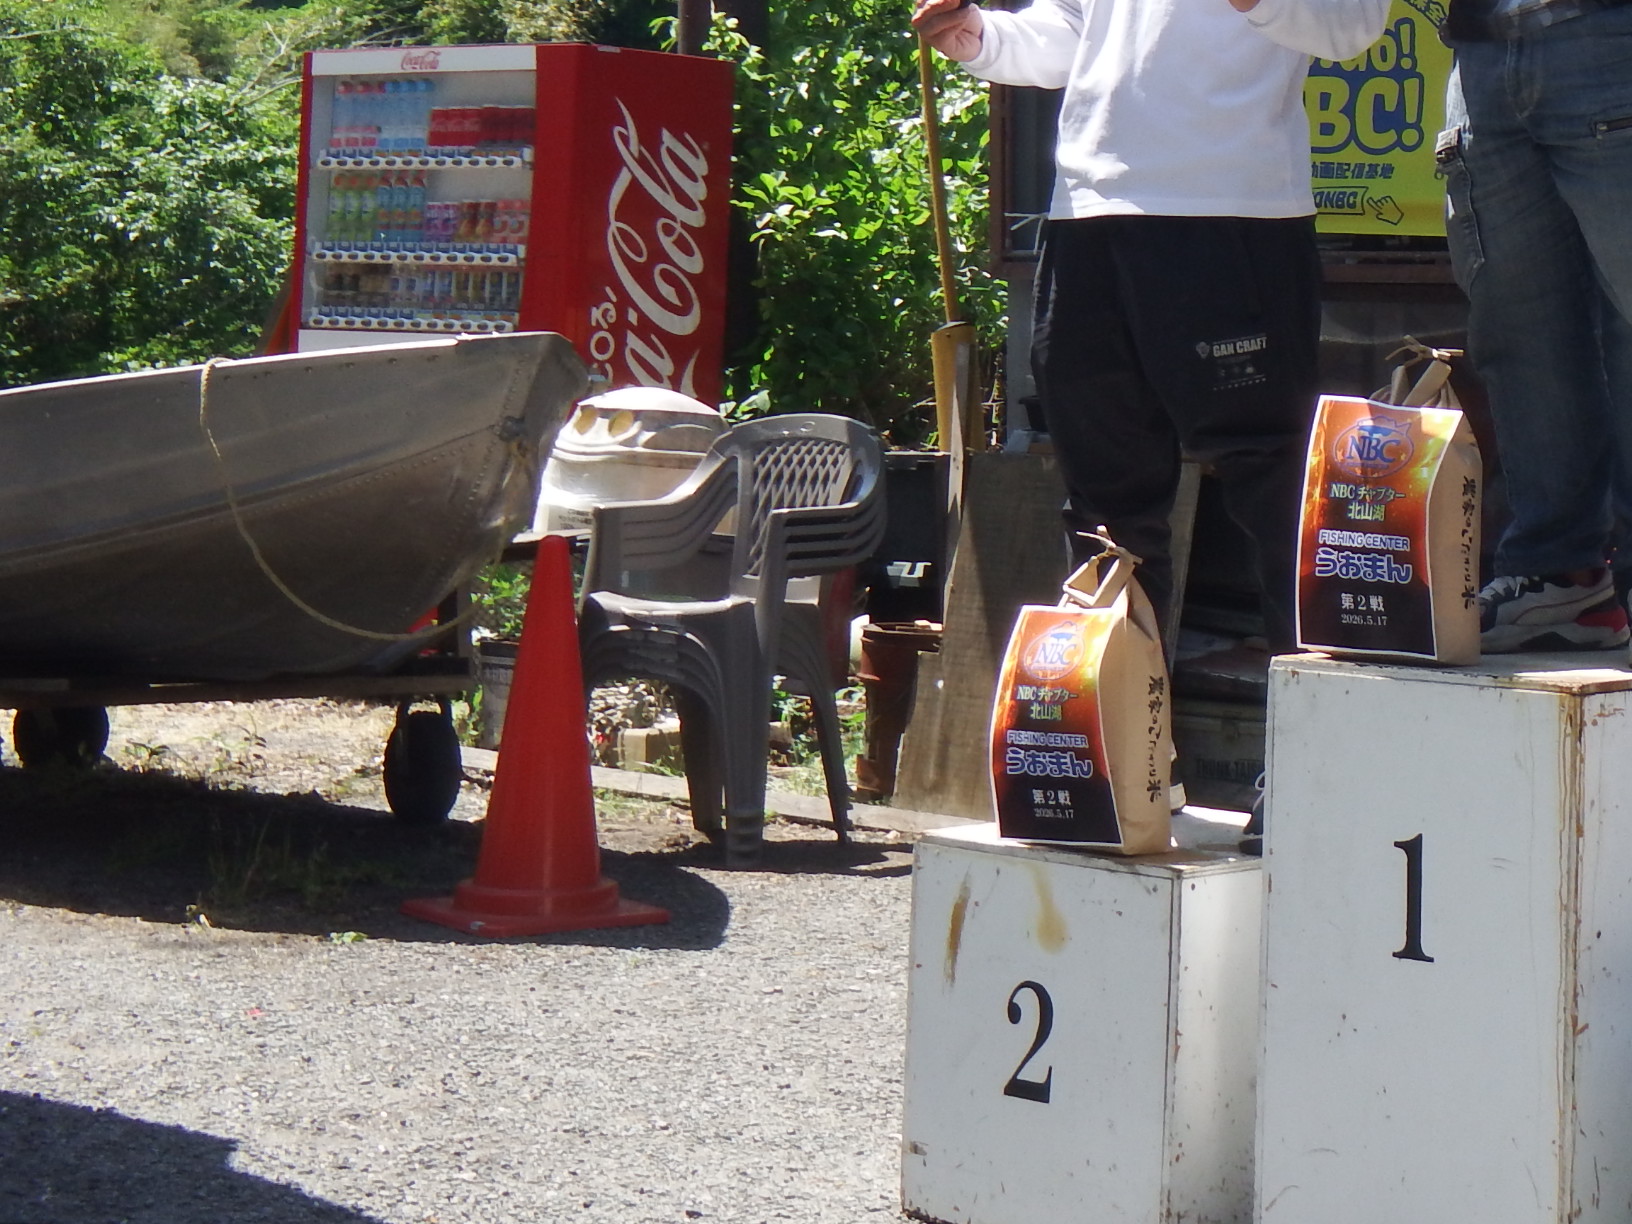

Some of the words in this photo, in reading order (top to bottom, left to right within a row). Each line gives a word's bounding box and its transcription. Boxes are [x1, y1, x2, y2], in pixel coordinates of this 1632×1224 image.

[401, 50, 441, 71] Coca-Cola
[1303, 74, 1423, 154] BC!
[1314, 190, 1358, 210] ONBC
[607, 96, 709, 398] a-Cola
[1213, 343, 1235, 358] GAN
[1236, 337, 1267, 353] CRAFT
[1346, 434, 1401, 464] NBC
[1330, 483, 1356, 499] NBC
[1357, 484, 1407, 503] チャプター
[1348, 503, 1386, 522] 北山湖
[1318, 529, 1364, 548] FISHING
[1365, 535, 1411, 552] CENTER
[1315, 548, 1413, 584] うおまん
[1034, 642, 1076, 665] NBC
[1030, 703, 1063, 721] 北山湖
[1006, 730, 1045, 746] FISHING
[1047, 733, 1089, 749] CENTER
[1006, 747, 1094, 779] うおまん
[1391, 832, 1435, 964] 1
[1003, 979, 1055, 1105] 2
